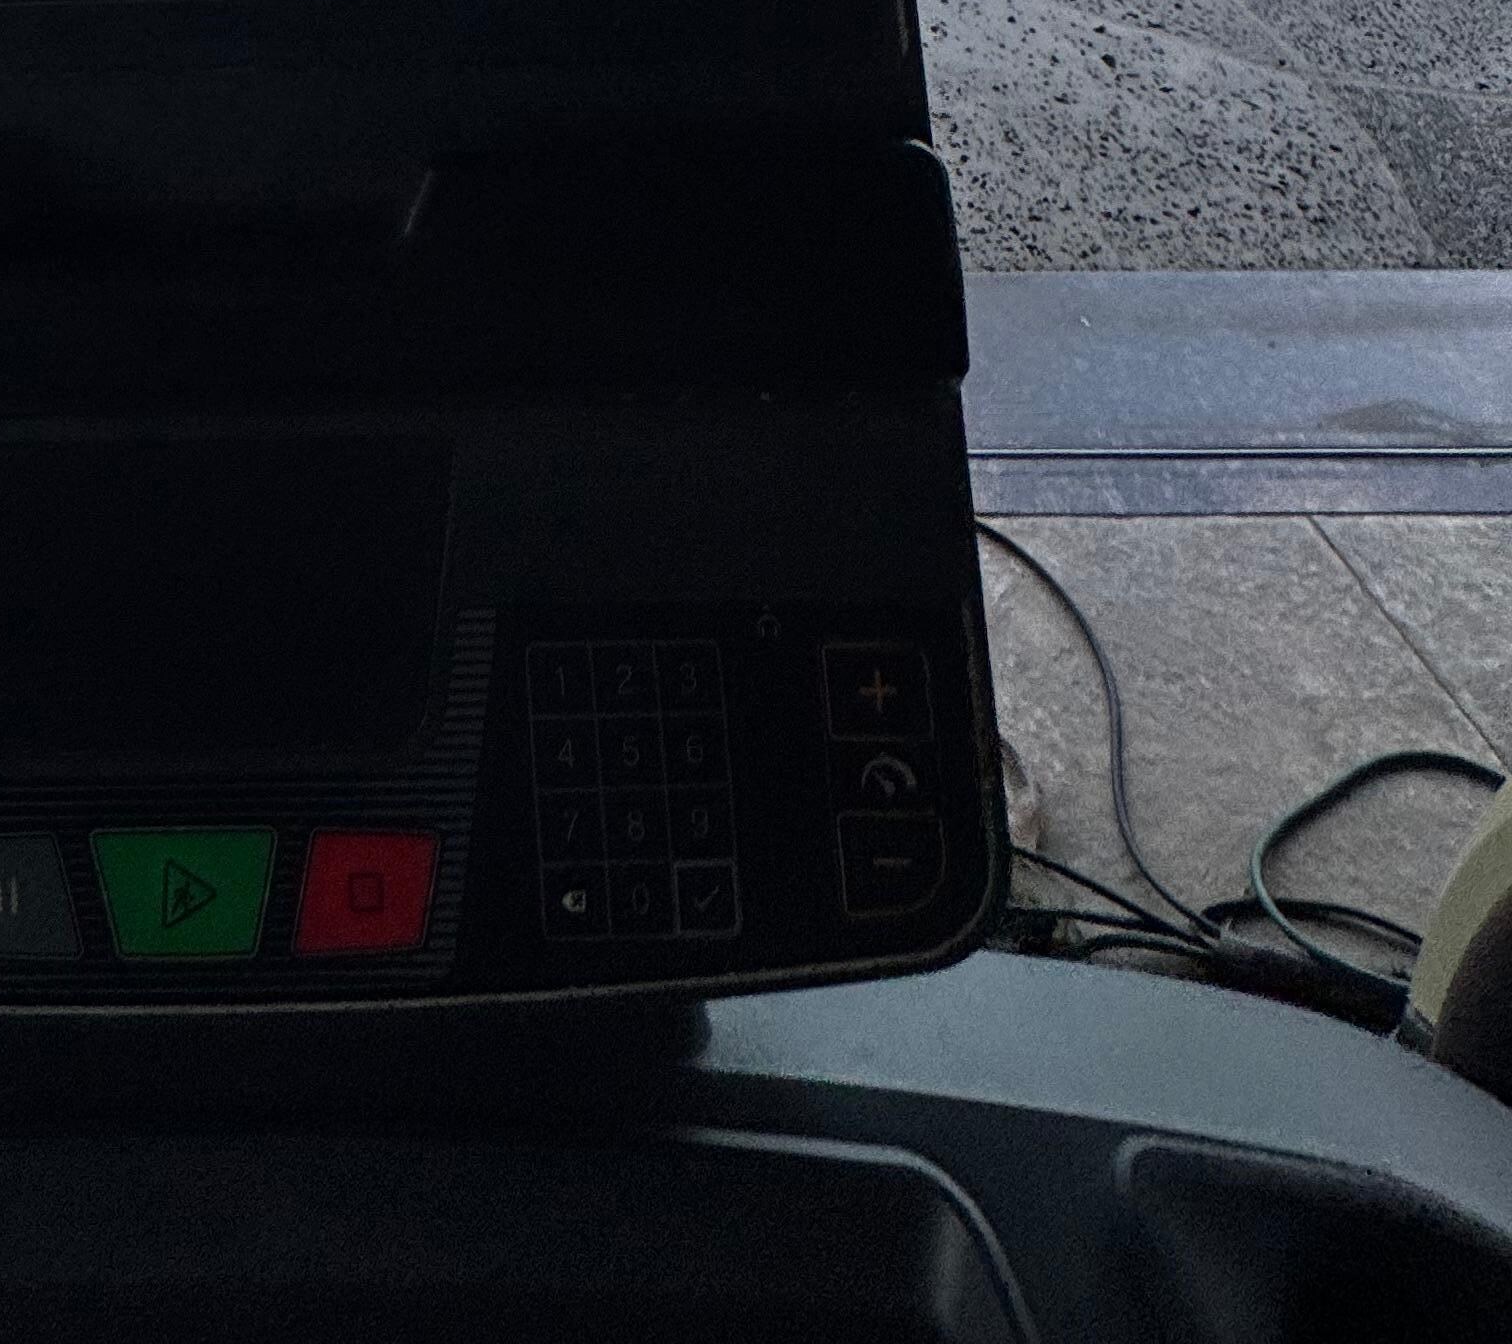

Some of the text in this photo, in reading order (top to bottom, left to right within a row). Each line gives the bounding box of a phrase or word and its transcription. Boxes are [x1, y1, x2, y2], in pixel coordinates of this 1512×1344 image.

[616, 664, 633, 696] 2
[679, 662, 698, 695] 3
[556, 734, 704, 769] 4 5 6
[563, 808, 709, 843] 7 8 9
[632, 883, 649, 915] 0
